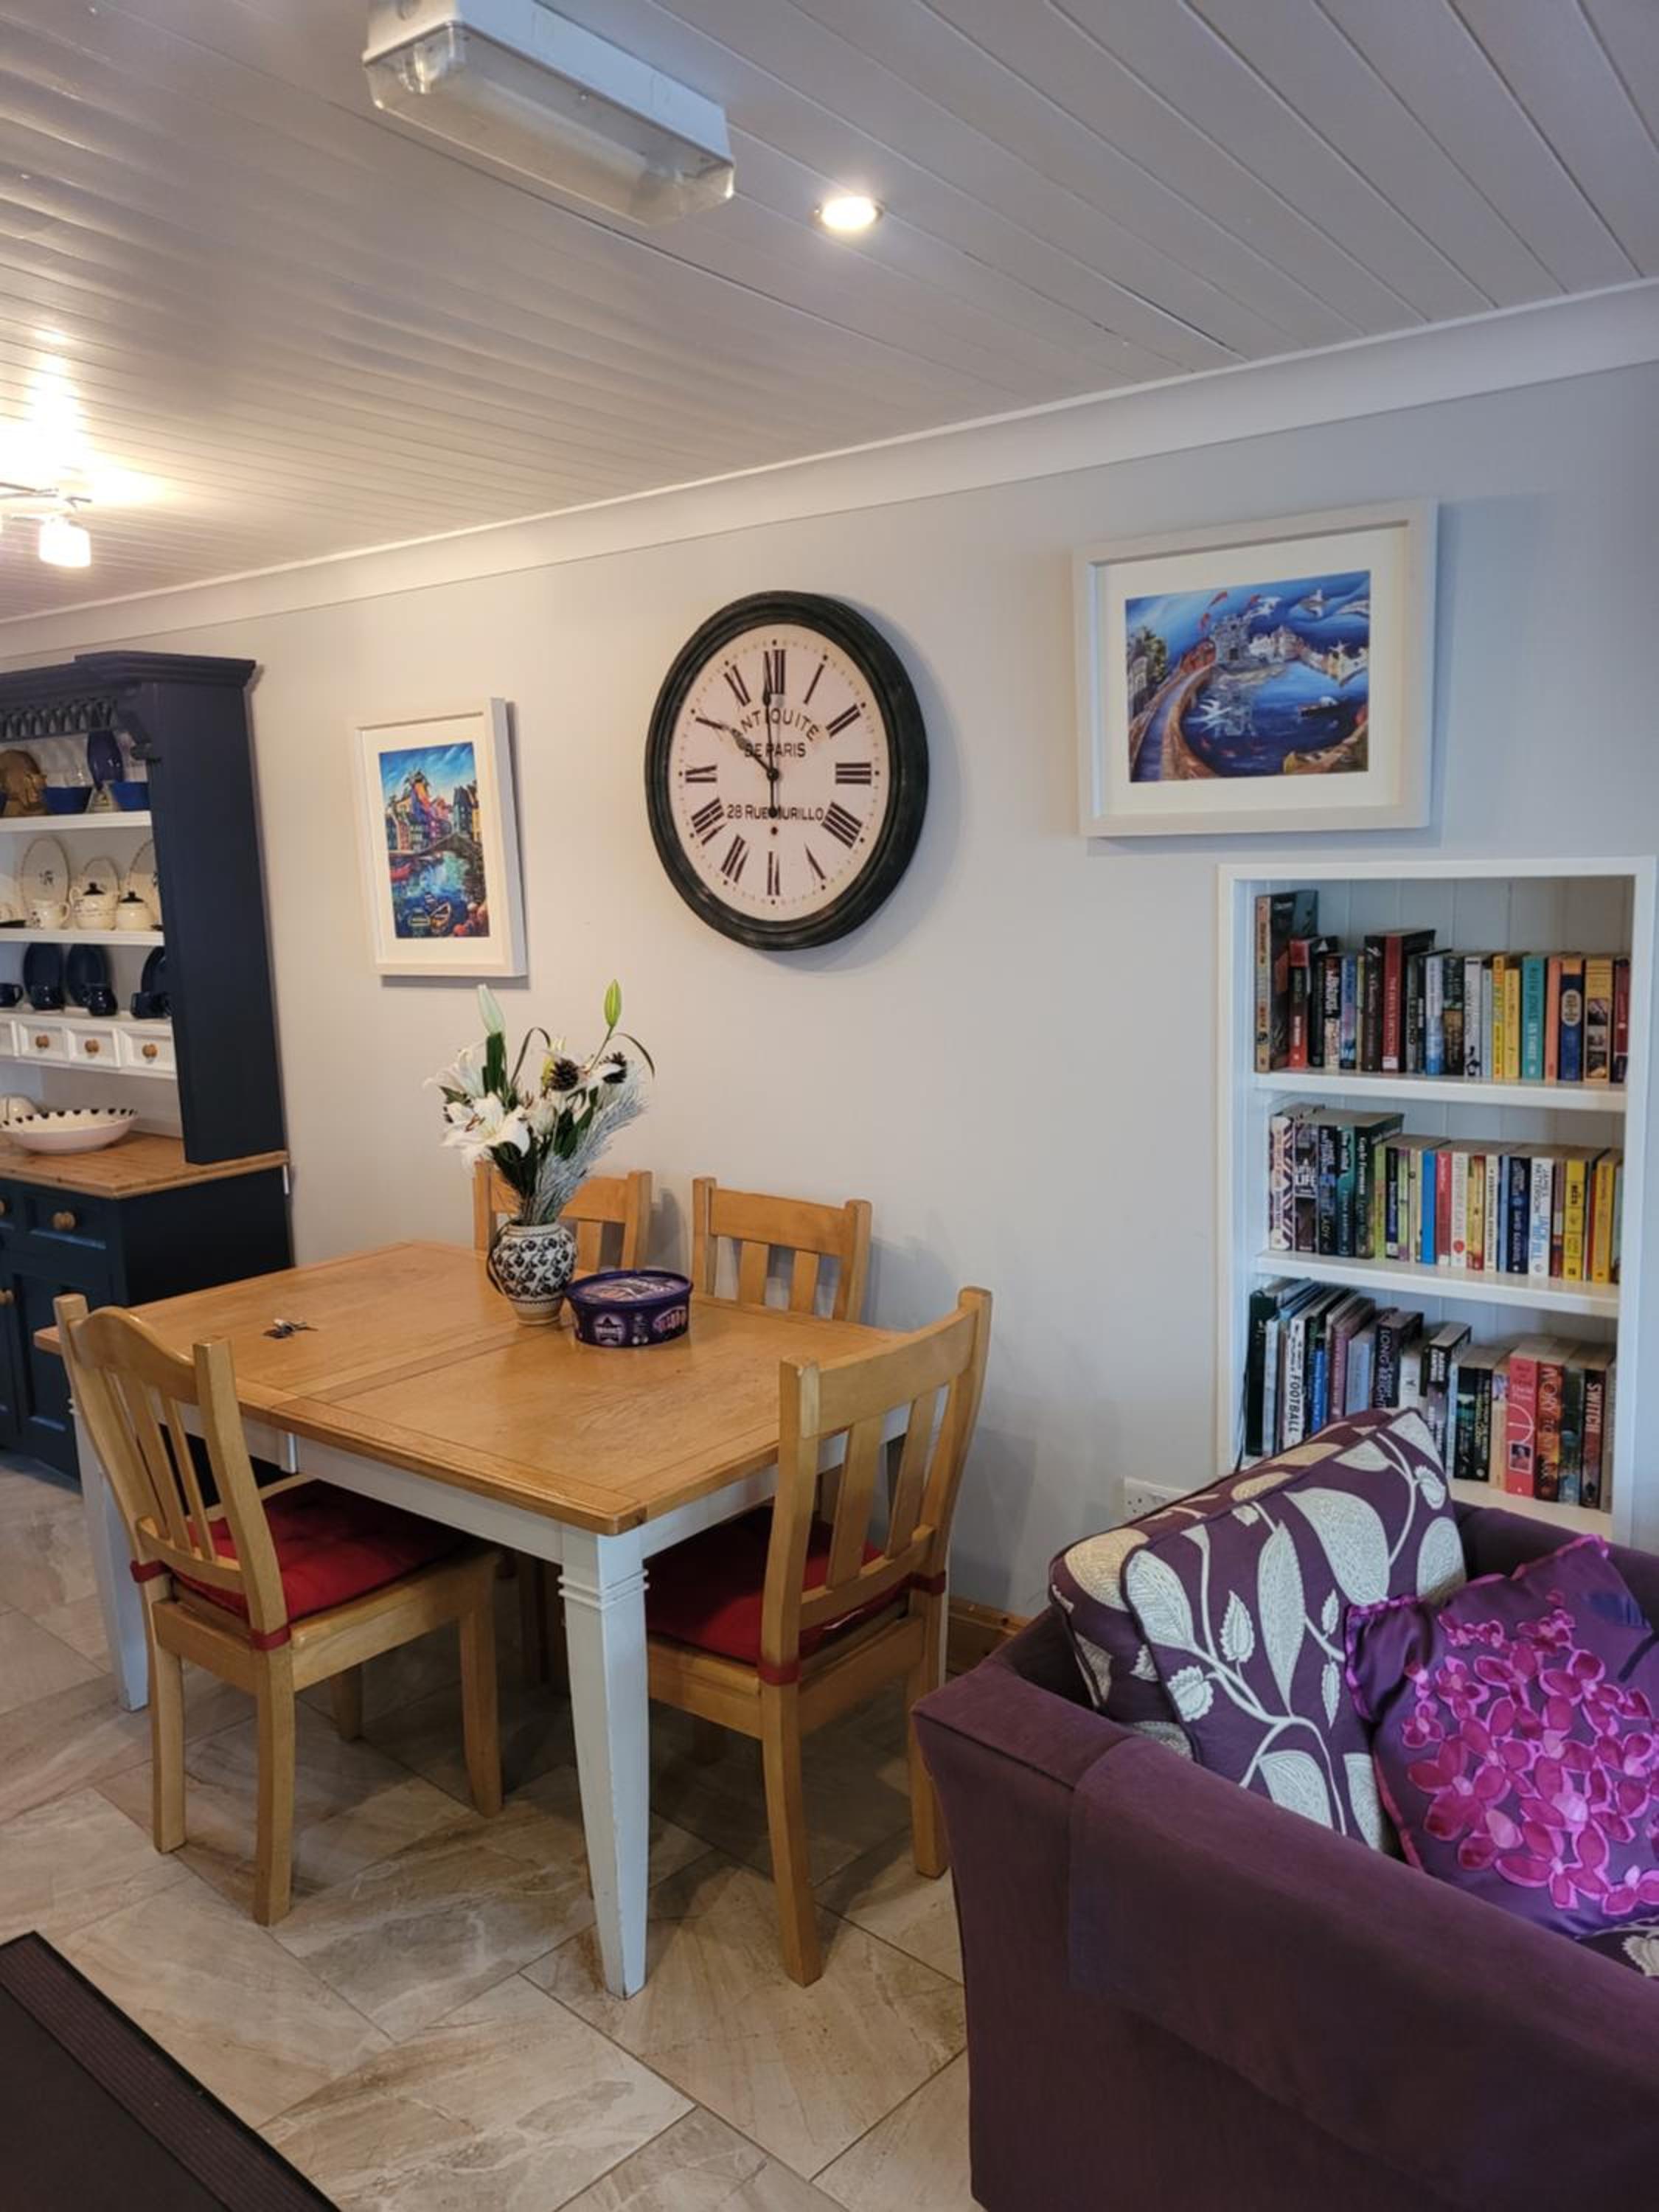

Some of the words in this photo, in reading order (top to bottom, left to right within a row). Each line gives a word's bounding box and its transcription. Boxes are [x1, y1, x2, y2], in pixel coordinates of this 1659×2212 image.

[739, 707, 820, 742] NTIQUITE
[765, 742, 807, 758] PARIS
[835, 762, 872, 785] III
[726, 804, 742, 819] 28
[1358, 1161, 1367, 1194] Forman
[1534, 1164, 1542, 1214] PATTERSON
[1541, 1169, 1549, 1197] JAMES
[1321, 1215, 1330, 1238] LADY
[1380, 1329, 1392, 1363] LONG
[1289, 1374, 1301, 1433] FOOTBALL
[1585, 1382, 1601, 1434] SWITCH
